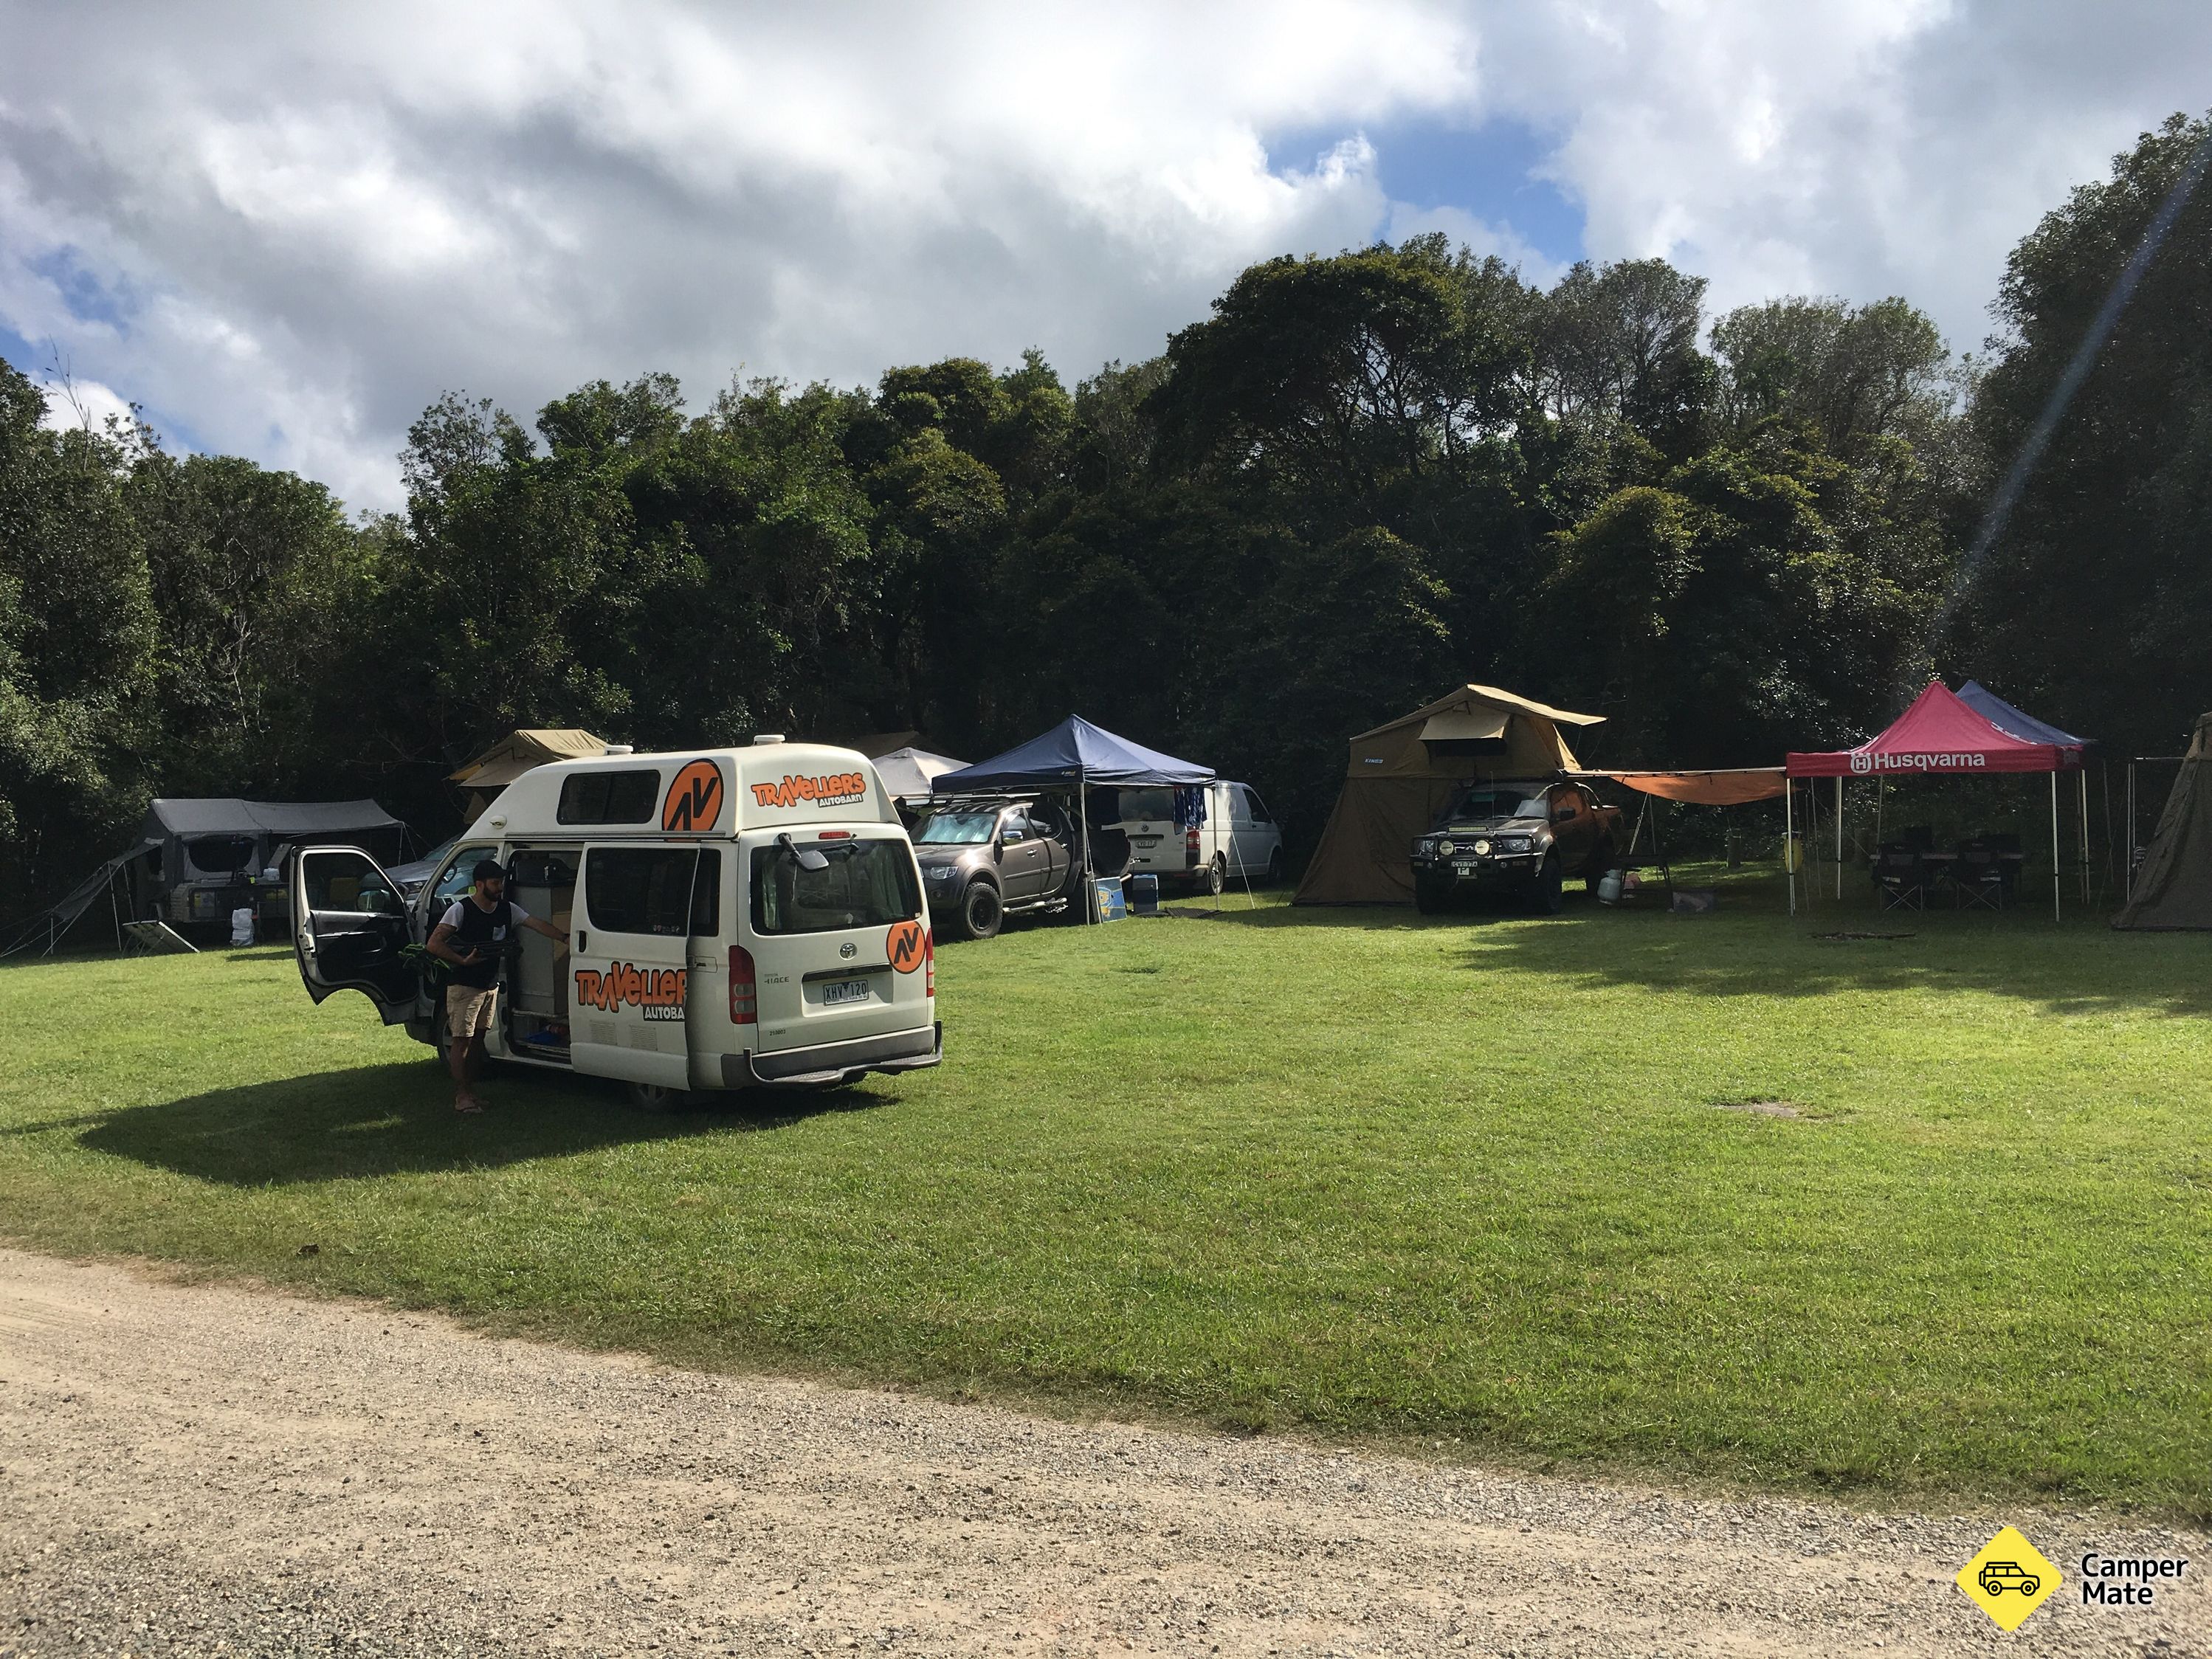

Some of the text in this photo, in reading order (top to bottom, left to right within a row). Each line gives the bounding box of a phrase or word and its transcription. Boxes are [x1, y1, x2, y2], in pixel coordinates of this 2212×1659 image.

[1875, 752, 1985, 771] Husqvarna
[825, 985, 843, 1000] XHV
[850, 982, 867, 996] 120
[644, 1006, 685, 1020] AUTOBA
